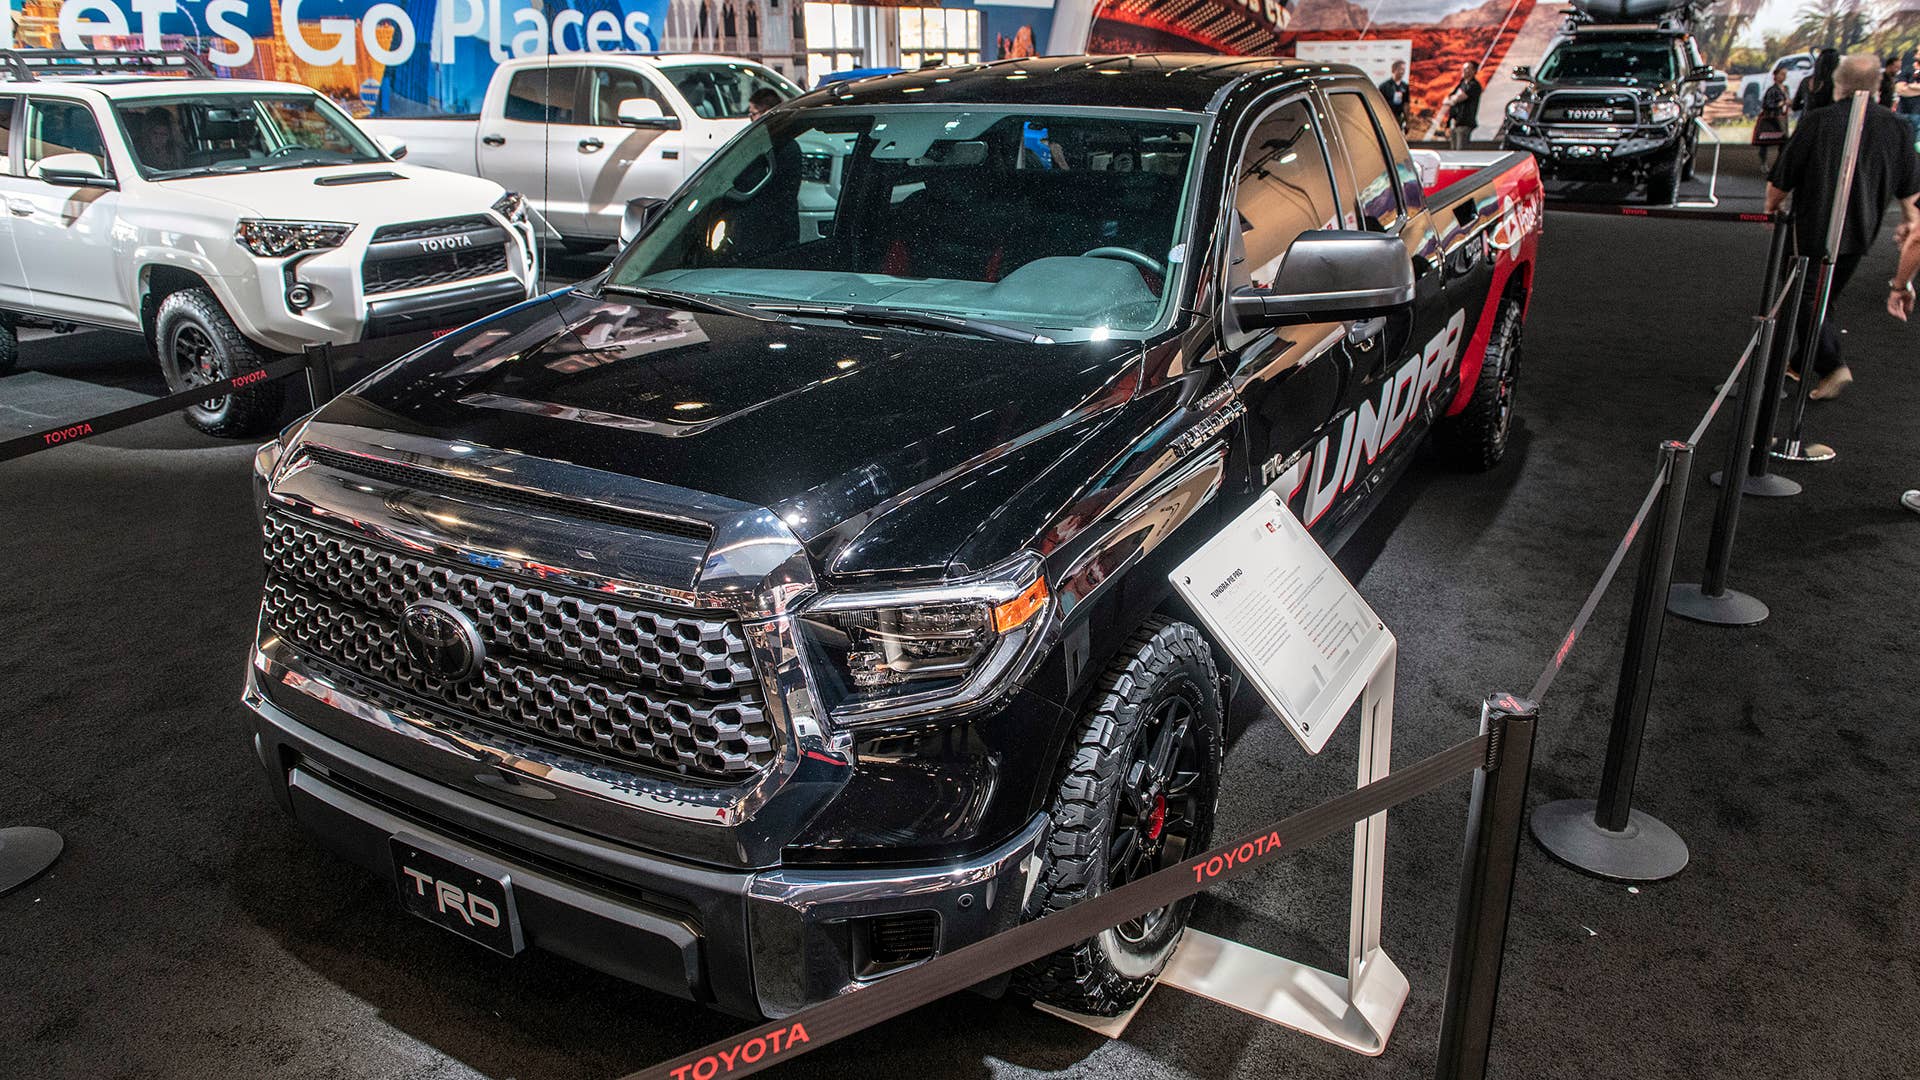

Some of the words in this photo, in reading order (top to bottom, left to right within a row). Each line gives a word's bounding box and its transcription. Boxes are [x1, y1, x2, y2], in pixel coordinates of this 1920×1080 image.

[281, 0, 416, 66] Go
[442, 0, 651, 64] Places
[1567, 109, 1610, 120] TOYOTA
[420, 235, 472, 252] TOYOTA
[231, 369, 268, 388] TOYOTA
[44, 423, 93, 444] TOYOTA
[1210, 580, 1230, 599] TUNDRA
[1193, 831, 1282, 883] TOYOTA
[403, 866, 500, 928] TRD
[670, 1023, 810, 1080] TOYOTA
